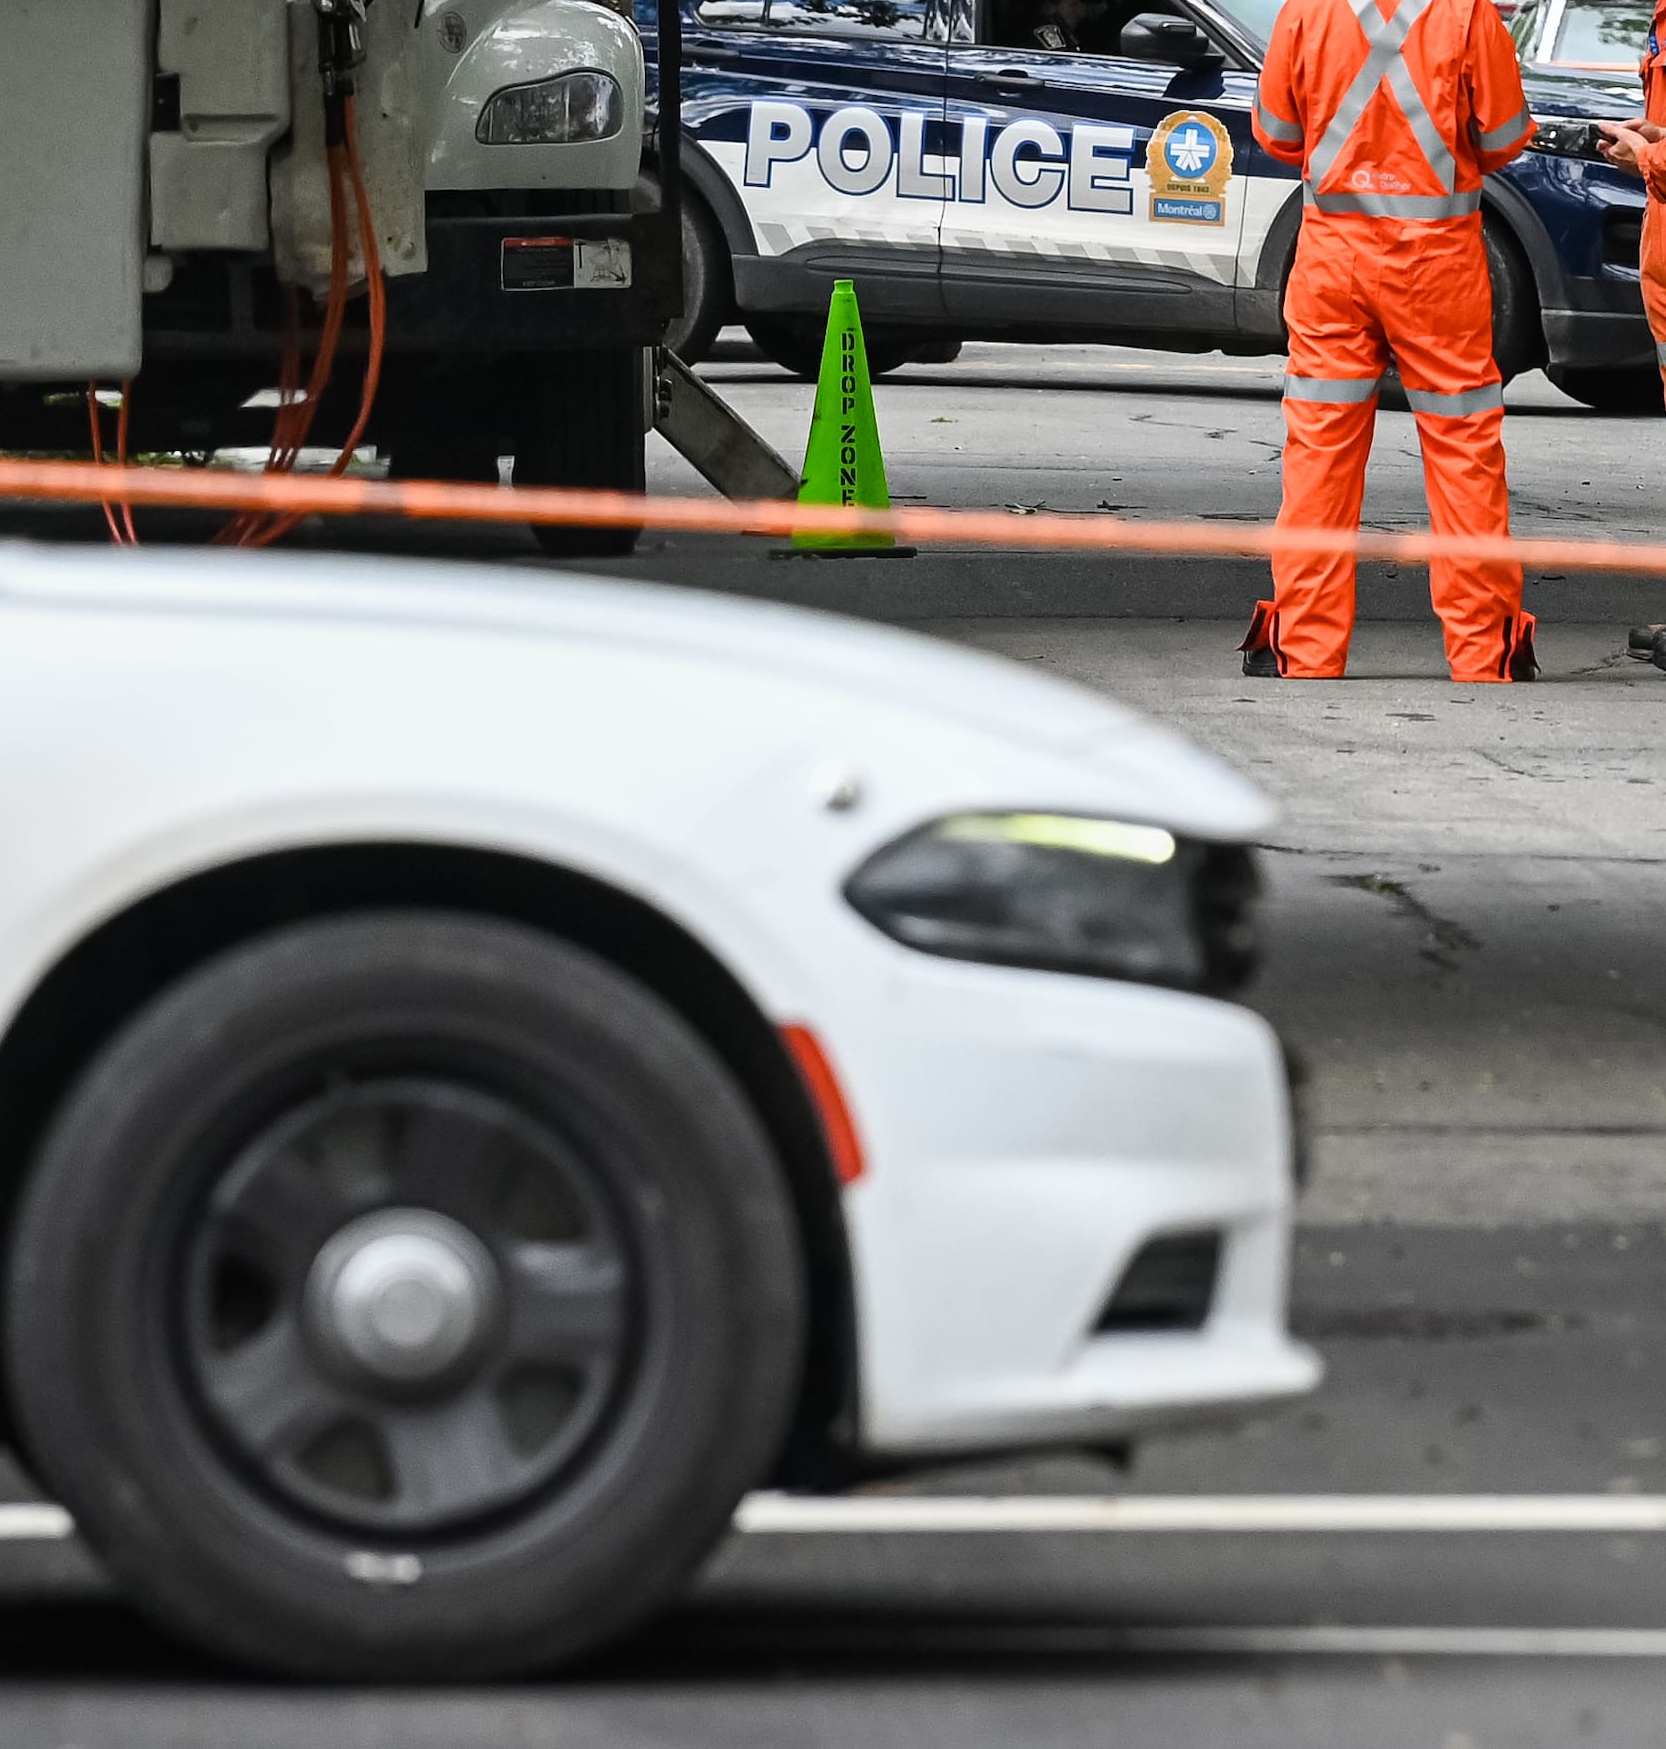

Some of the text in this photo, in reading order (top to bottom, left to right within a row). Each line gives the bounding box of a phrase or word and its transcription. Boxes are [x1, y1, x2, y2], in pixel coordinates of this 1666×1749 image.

[744, 99, 1134, 214] POLICE
[1157, 202, 1203, 217] Montréal
[841, 332, 856, 415] DROP
